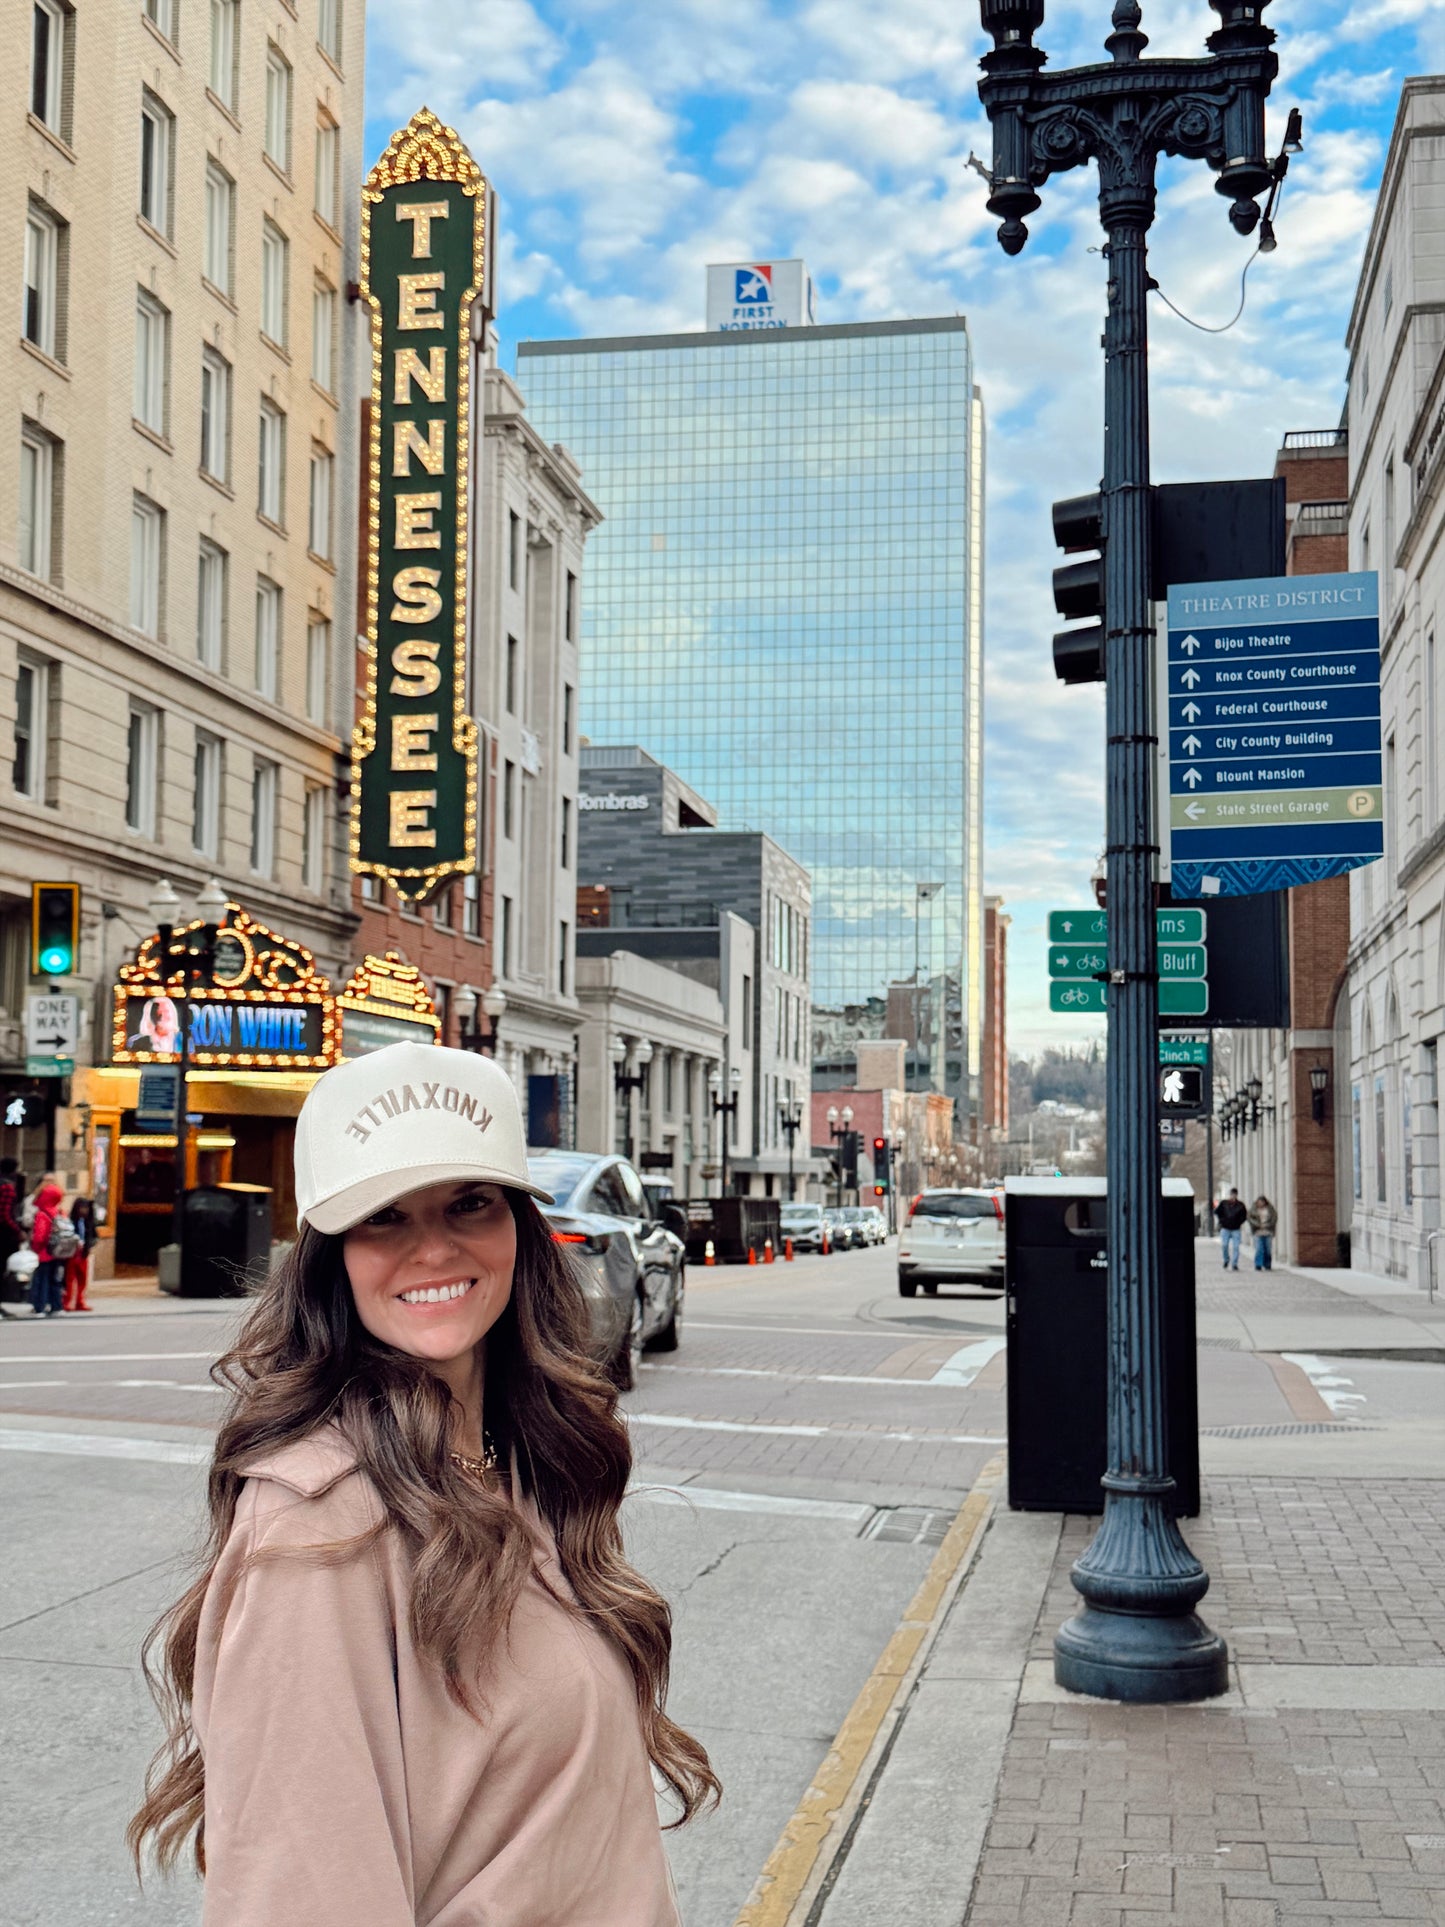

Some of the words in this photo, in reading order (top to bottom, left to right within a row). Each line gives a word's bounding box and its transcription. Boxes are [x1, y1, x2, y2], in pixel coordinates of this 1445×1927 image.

[733, 306, 774, 319] FIRST
[389, 201, 449, 848] TENNESSEE
[1181, 594, 1270, 614] THEATRE
[1276, 587, 1365, 608] DISTRICT
[1215, 637, 1244, 651] Bijou
[1248, 634, 1291, 647] Theatre
[1216, 671, 1242, 682] Knox
[1247, 667, 1286, 681] County
[1290, 664, 1357, 678] Courthouse
[1216, 702, 1258, 715] Federal
[1262, 700, 1328, 713] Courthouse
[1216, 737, 1237, 750] City
[1241, 734, 1281, 748] County
[1285, 732, 1333, 746] Building
[1216, 770, 1253, 782] Blount
[1258, 768, 1305, 780] Mansion
[577, 793, 649, 810] Tombras
[1216, 804, 1246, 816] State
[1250, 802, 1283, 814] Street
[1288, 801, 1329, 814] Garage
[1356, 796, 1368, 811] P
[1163, 953, 1196, 970] Bluff
[37, 999, 70, 1013] ONE
[36, 1016, 70, 1029] WAY
[237, 1006, 308, 1050] WHITE
